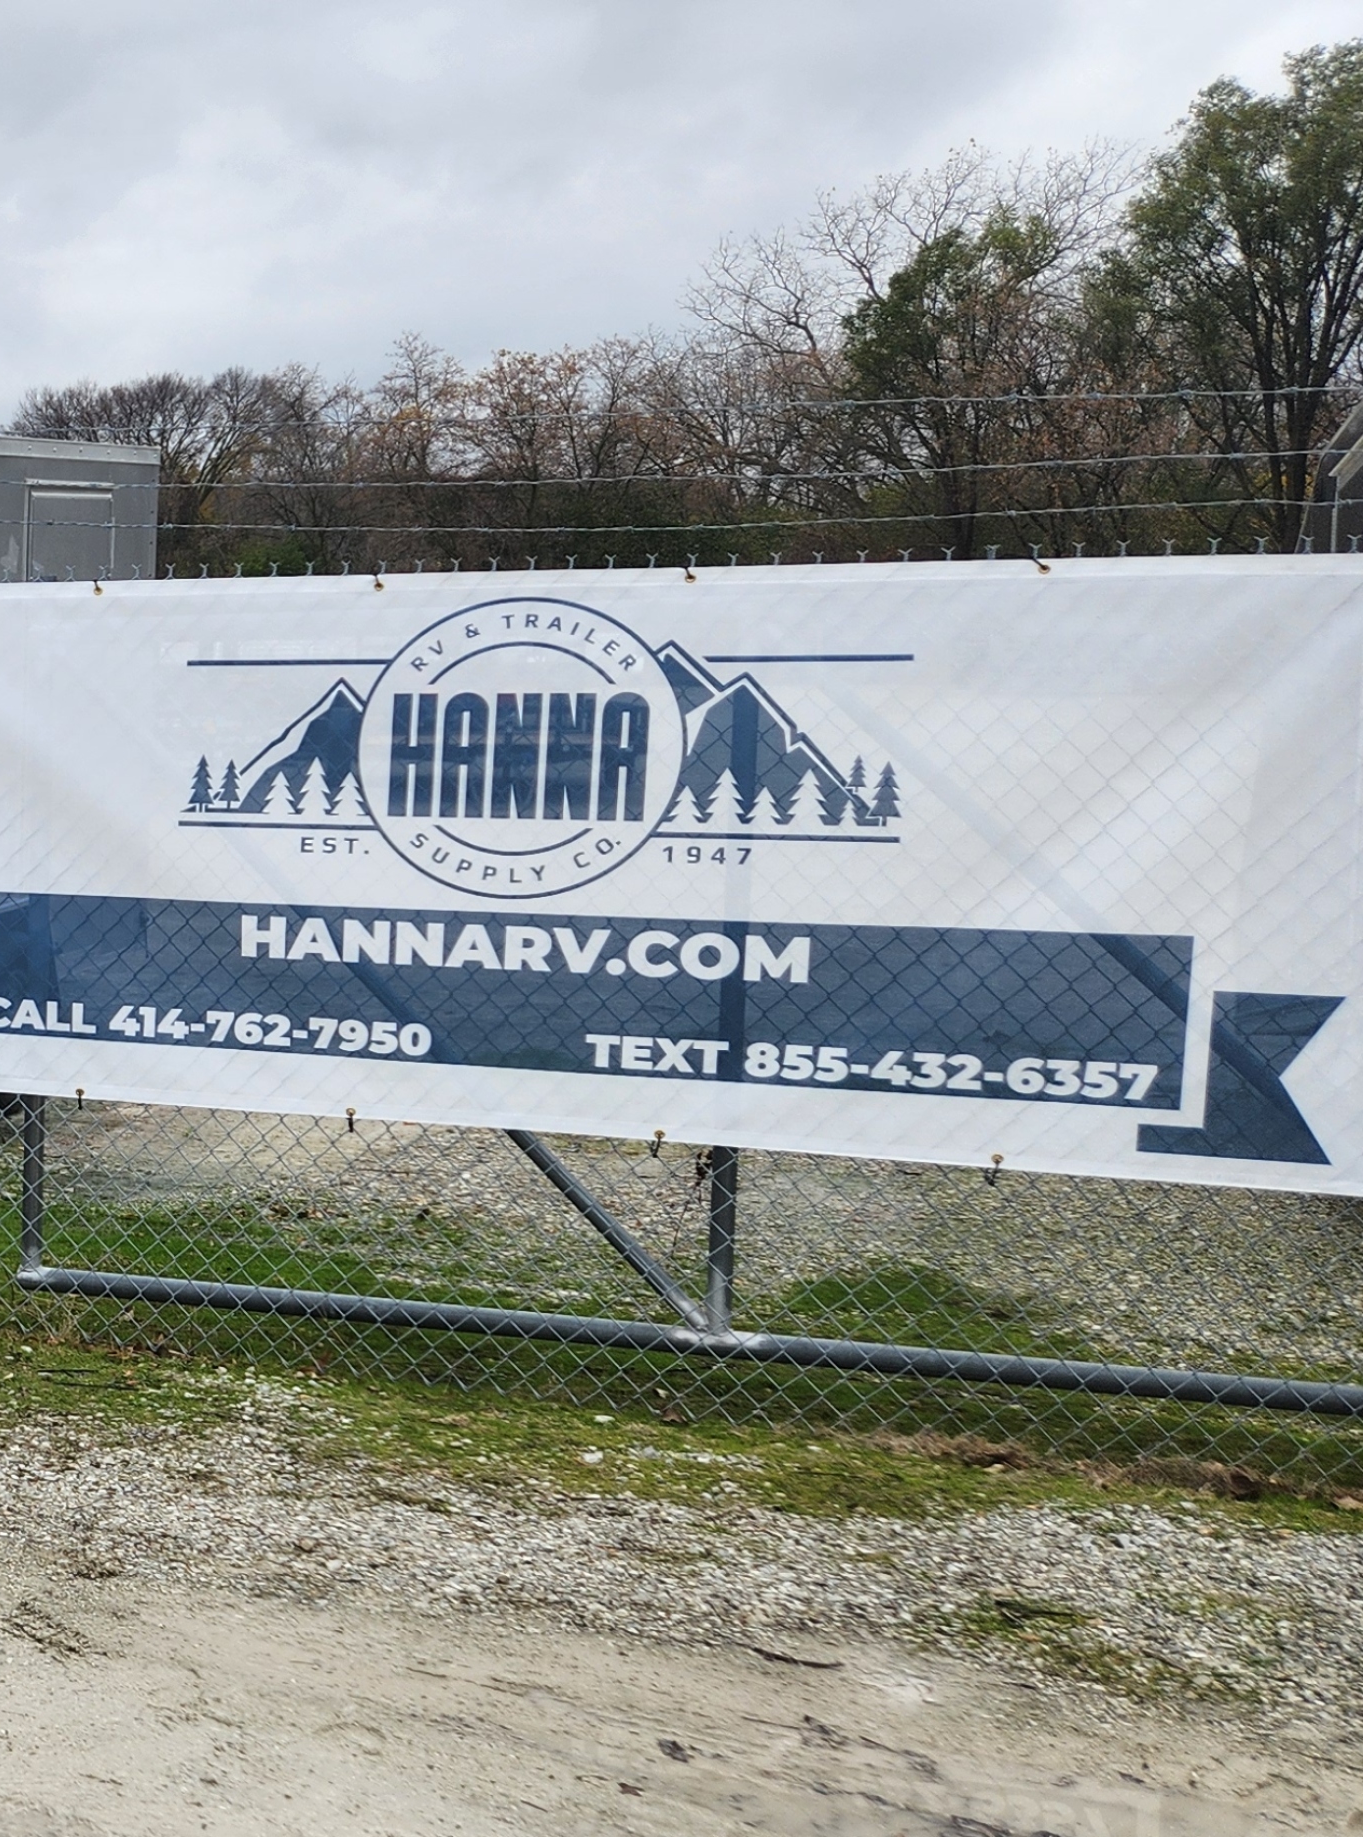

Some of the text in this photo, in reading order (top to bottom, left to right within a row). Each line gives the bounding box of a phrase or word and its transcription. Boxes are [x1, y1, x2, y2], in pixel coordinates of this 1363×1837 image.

[410, 613, 637, 672] RV & TRAILER
[387, 691, 651, 822] HANNA
[300, 836, 370, 855] EST.
[409, 831, 622, 884] SUPPLY CO.
[662, 845, 752, 866] 1947
[241, 913, 811, 984] HANNARV.COM
[108, 1004, 432, 1056] 414-762-7950
[585, 1033, 1159, 1100] TEXT 855-432-6357
